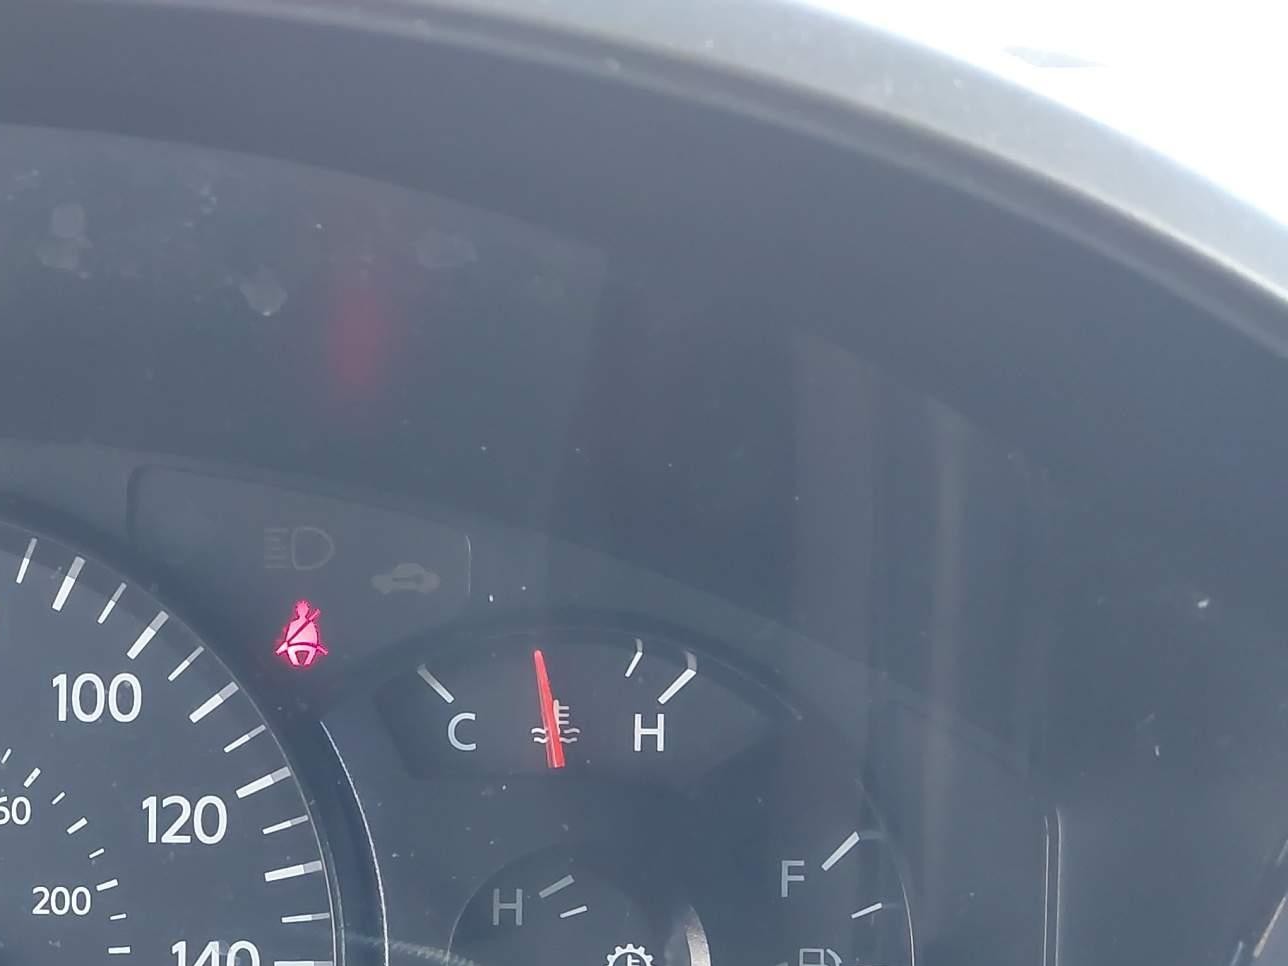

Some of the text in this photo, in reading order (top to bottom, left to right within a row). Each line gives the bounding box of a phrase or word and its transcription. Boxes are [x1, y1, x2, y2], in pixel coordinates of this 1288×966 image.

[52, 672, 142, 723] 100
[447, 712, 477, 751] C
[634, 713, 665, 752] H
[142, 795, 228, 845] 120
[781, 860, 805, 898] F
[32, 886, 91, 916] 200
[493, 888, 523, 926] H
